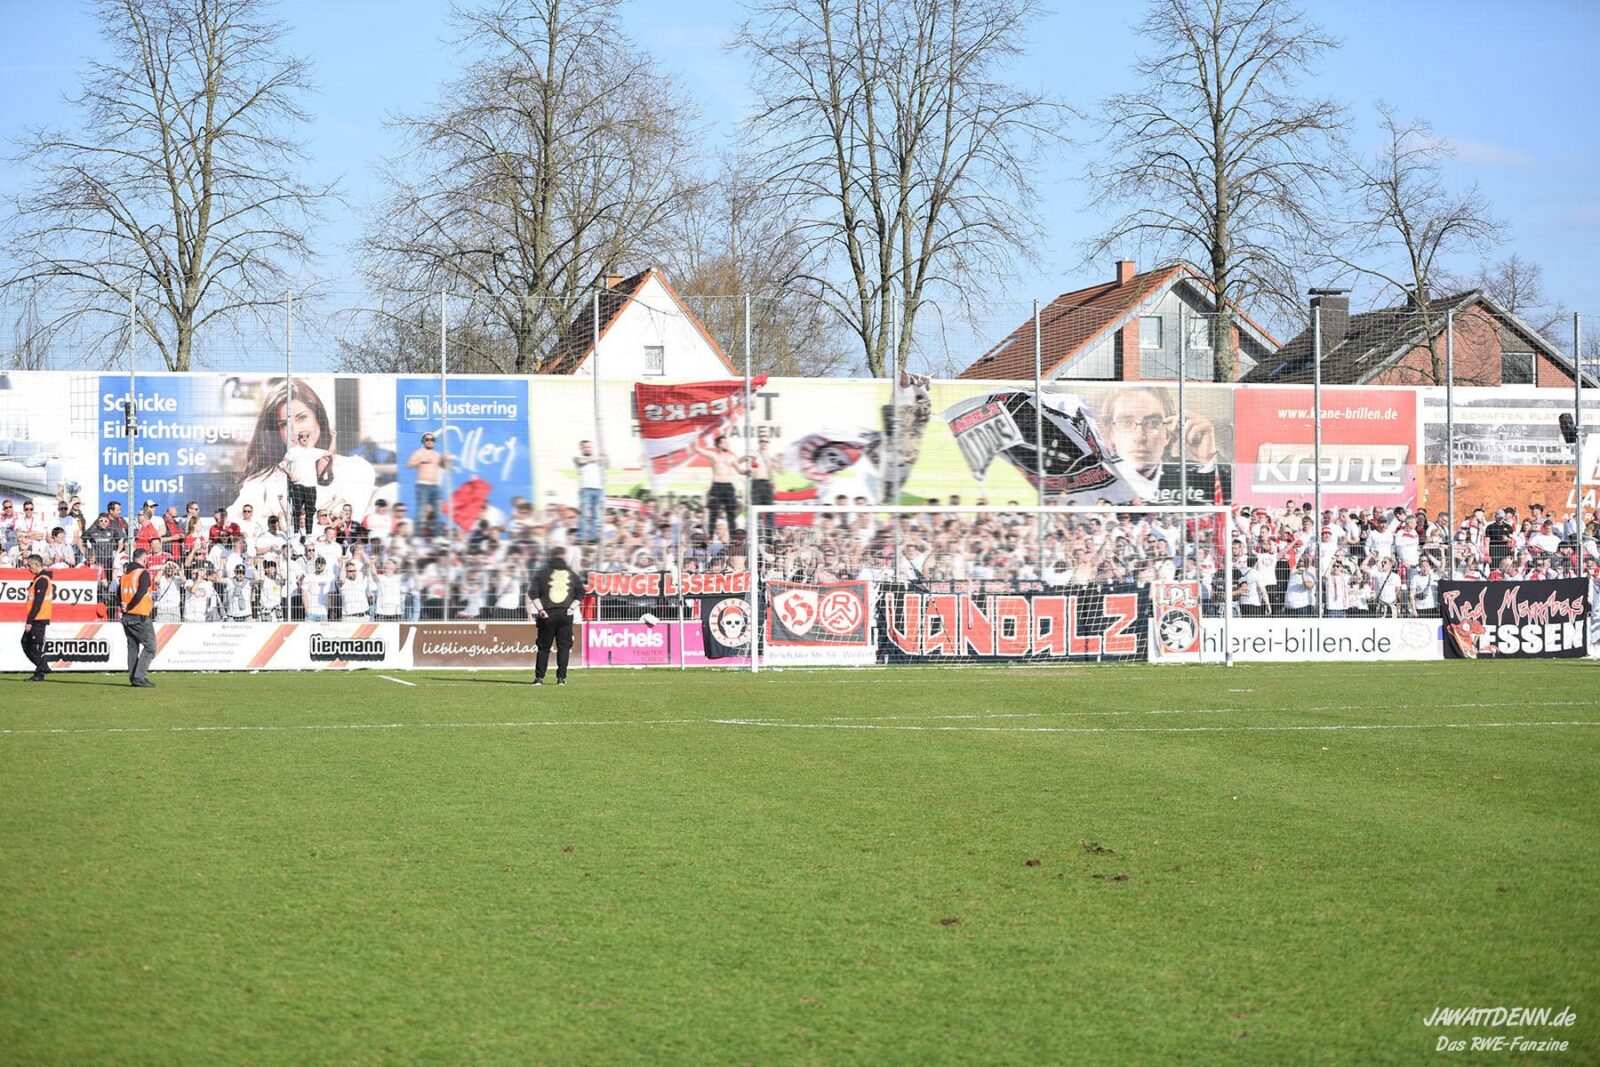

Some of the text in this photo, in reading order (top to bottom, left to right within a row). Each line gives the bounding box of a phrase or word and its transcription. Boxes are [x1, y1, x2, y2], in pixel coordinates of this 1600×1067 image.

[432, 400, 518, 419] Musterring
[1277, 406, 1398, 420] www.kane-brillen.de
[1529, 413, 1562, 421] PLAT
[102, 446, 208, 467] finden Sie
[1258, 447, 1401, 483] krane
[103, 473, 184, 494] be uns!
[583, 572, 661, 597] JUNGE
[1443, 585, 1585, 626] Red Mambas
[588, 627, 665, 649] Michels
[1203, 627, 1392, 654] hlerei-billen.de
[1478, 619, 1585, 655] ESSEN
[45, 639, 109, 657] ermann
[422, 641, 573, 657] lieblingsweinla
